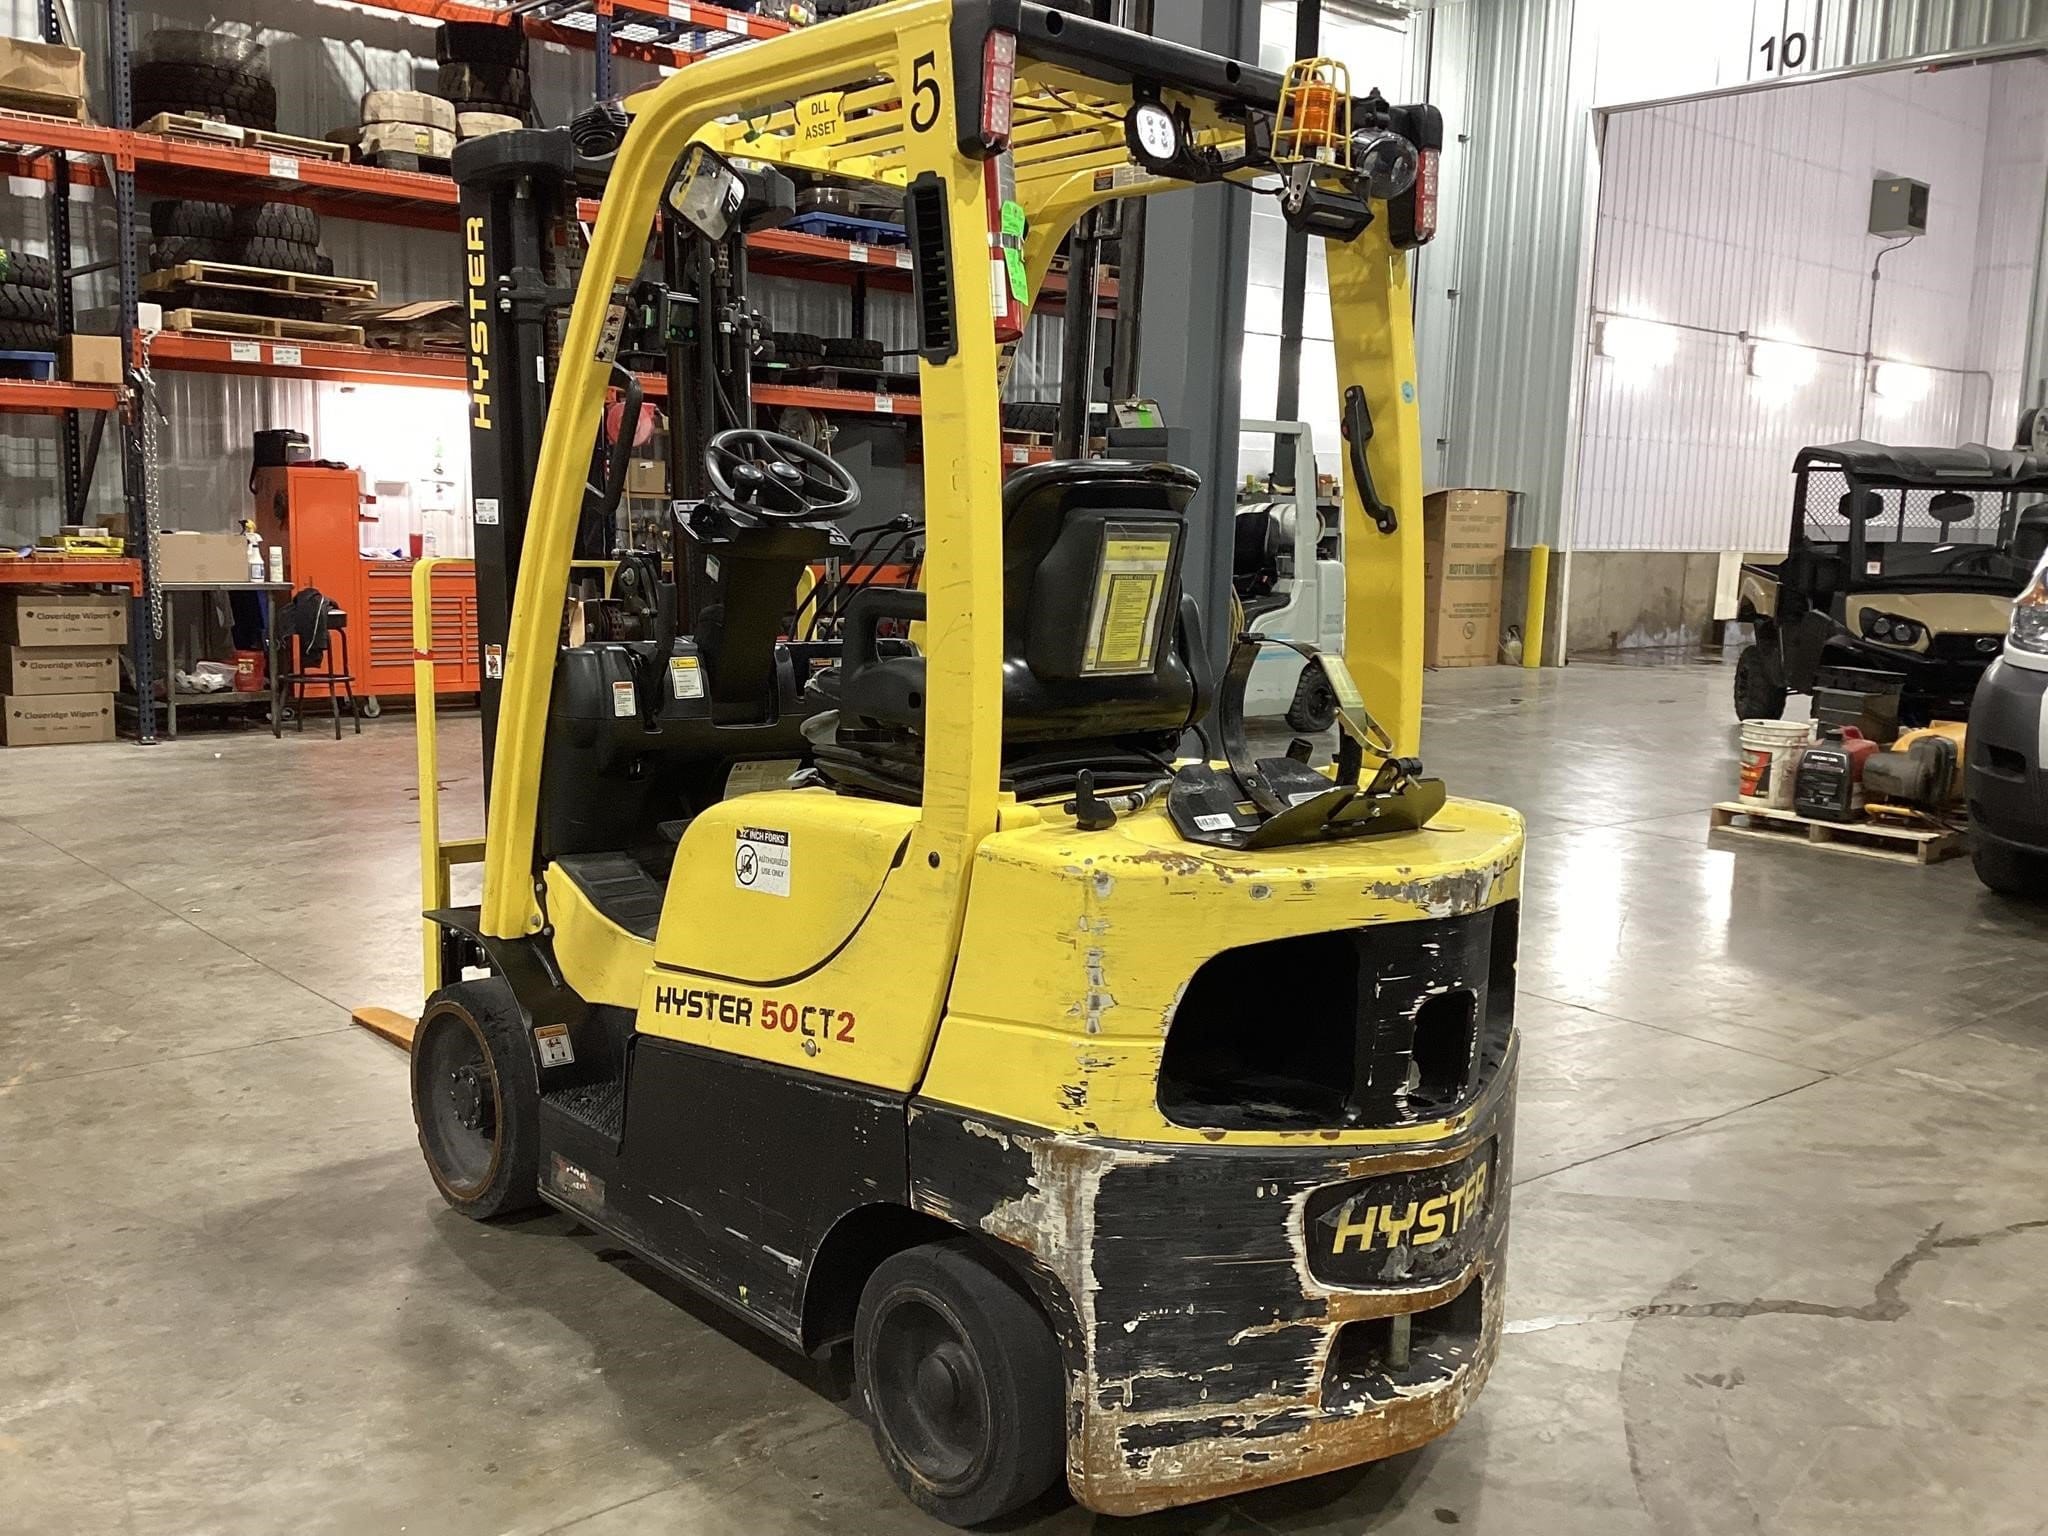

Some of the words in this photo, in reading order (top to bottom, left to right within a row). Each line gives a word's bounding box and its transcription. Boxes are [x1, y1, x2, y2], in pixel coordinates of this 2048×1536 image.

[1760, 32, 1806, 71] 10
[911, 50, 940, 132] 5
[811, 100, 830, 116] DLL
[805, 120, 836, 140] ASSET
[466, 217, 491, 430] HYSTER
[36, 611, 80, 621] Cloveridge
[82, 612, 111, 620] Wipers
[30, 661, 73, 670] Cloveridge
[75, 660, 104, 668] Wipers
[24, 711, 68, 720] Cloveridge
[70, 710, 99, 718] Wipers
[750, 830, 764, 841] INCH
[765, 832, 785, 844] FORKS
[759, 855, 788, 867] AUTHORIZED
[761, 867, 771, 876] USE
[655, 986, 753, 1027] HYSTER
[1332, 1161, 1487, 1255] HYSTER
